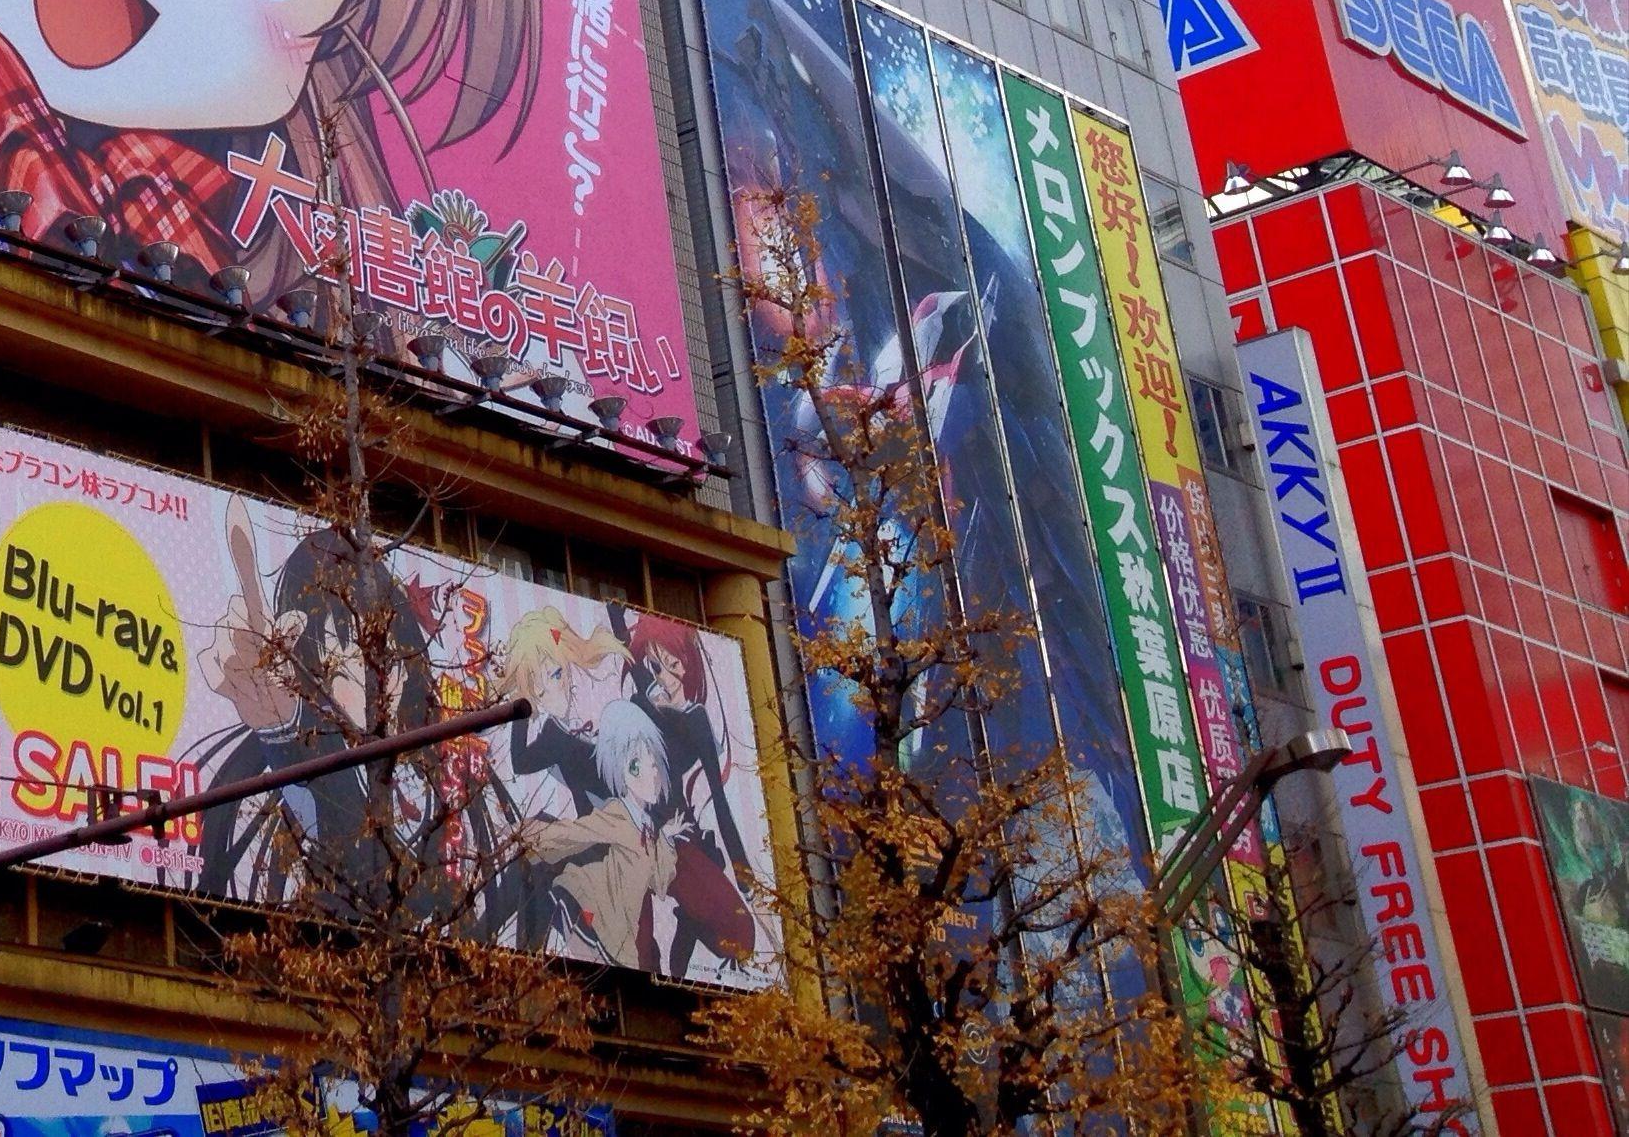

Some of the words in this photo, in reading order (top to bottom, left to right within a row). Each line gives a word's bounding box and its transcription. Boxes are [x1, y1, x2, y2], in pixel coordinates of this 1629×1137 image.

[227, 131, 681, 394] 大図書館の羊飼い
[1025, 105, 1200, 814] メロンブックス秋葉原店
[1249, 370, 1338, 560] AKKY
[1160, 493, 1214, 659] 价格优惠
[100, 672, 166, 734] Vol.1
[1319, 654, 1394, 815] DUTY
[1361, 840, 1437, 1006] FREE
